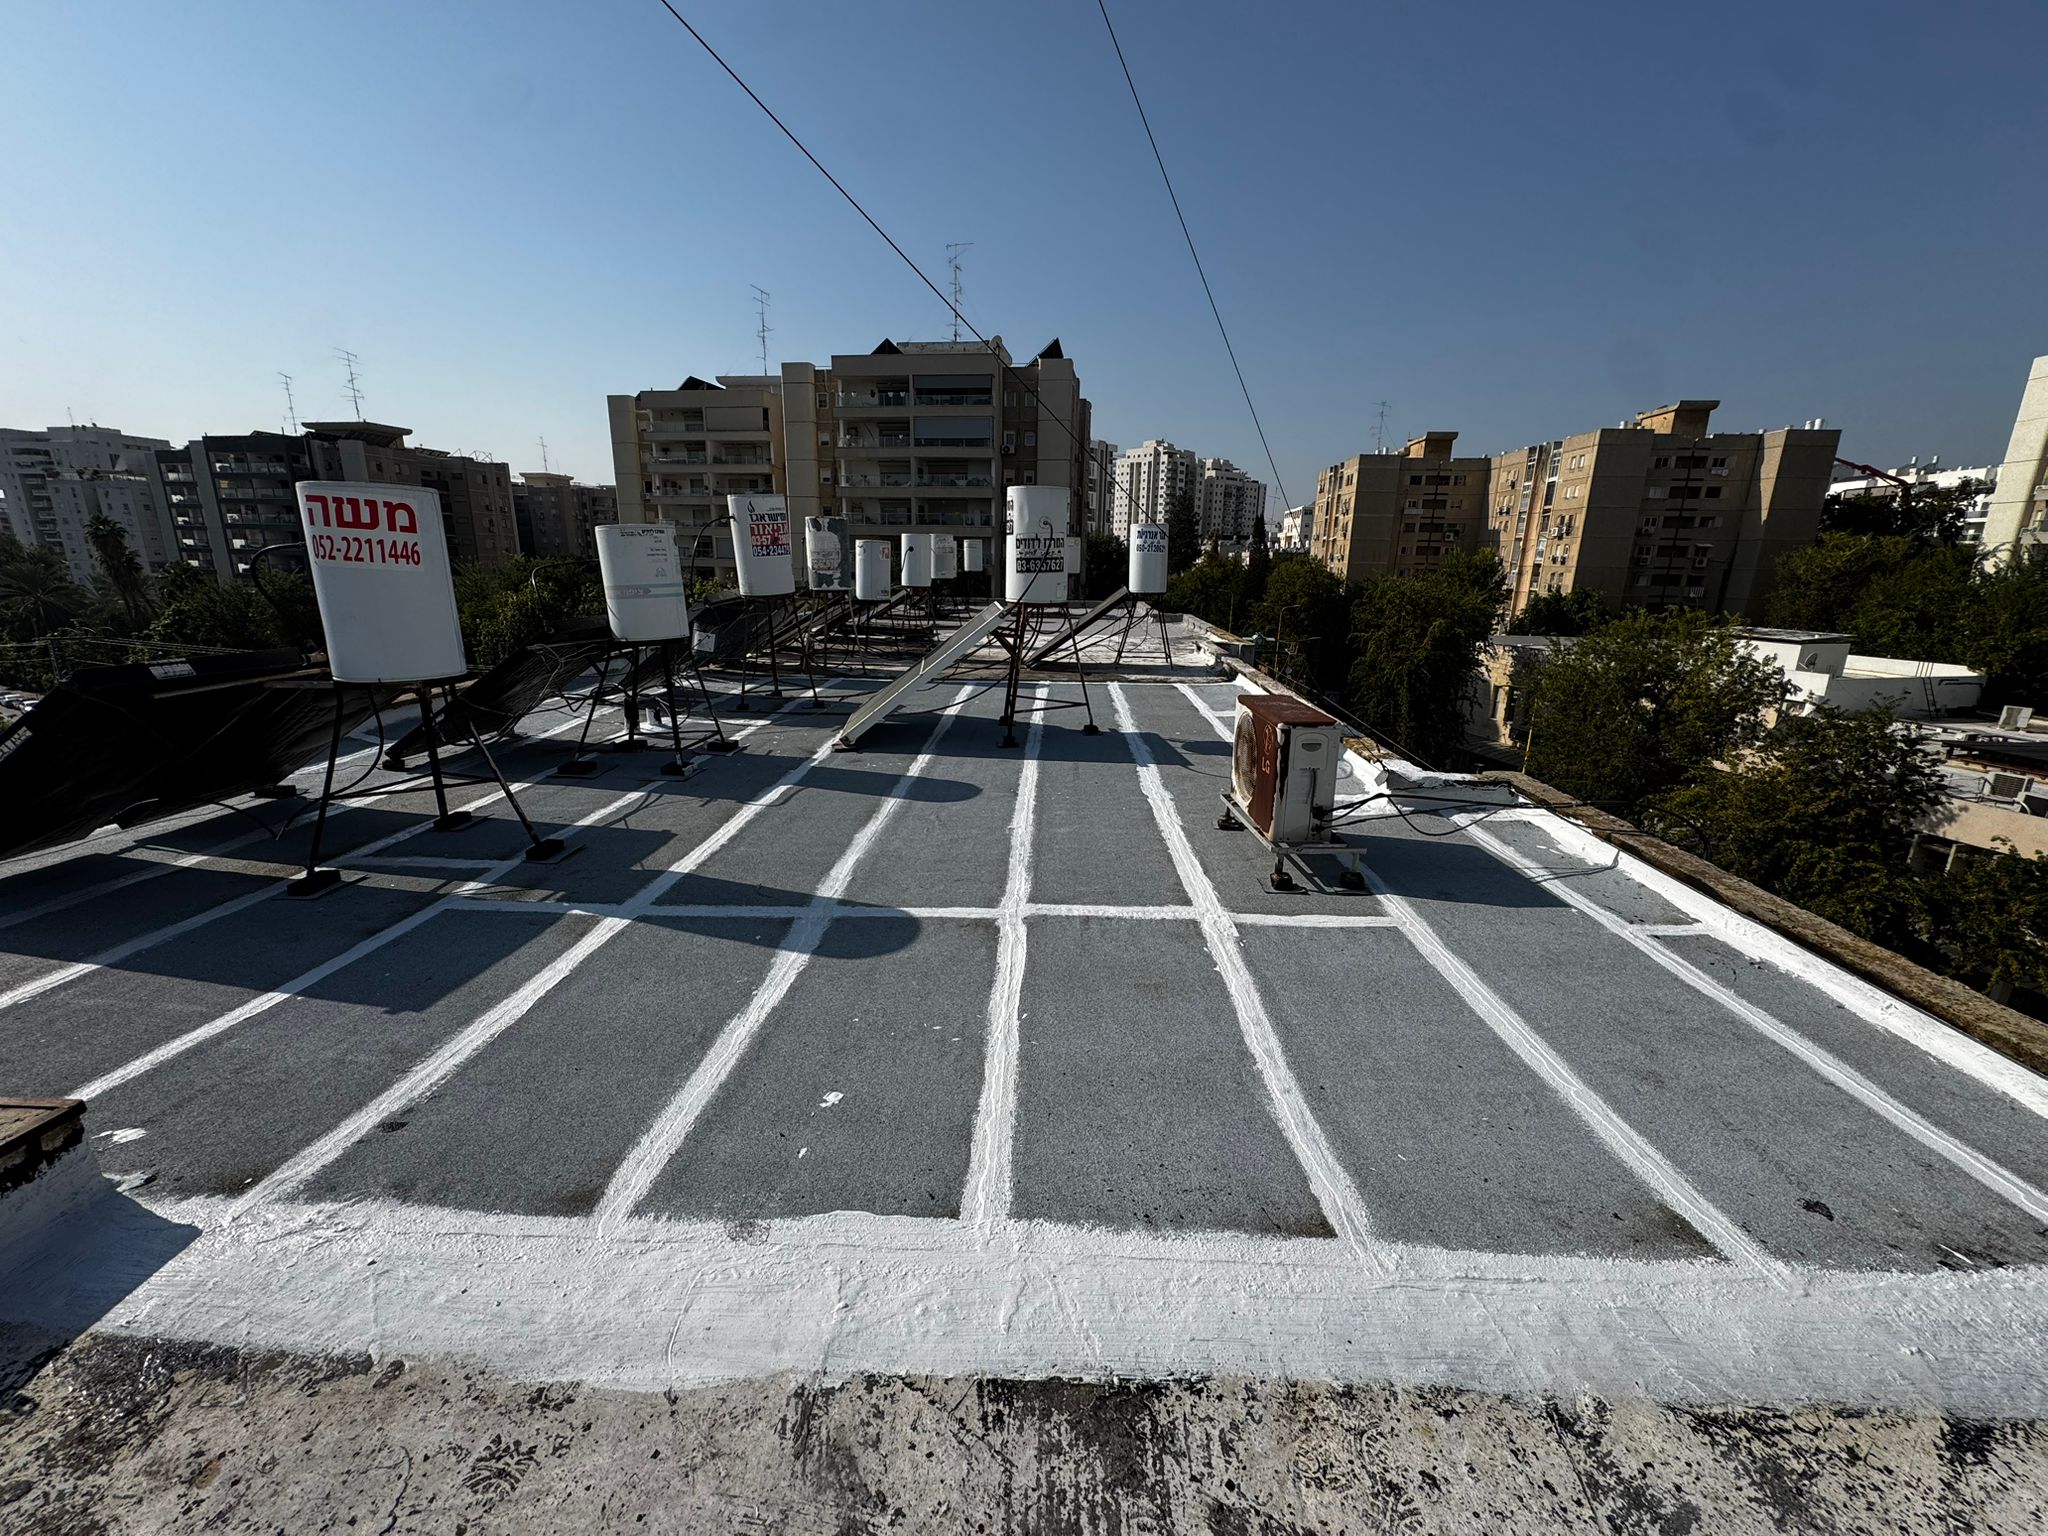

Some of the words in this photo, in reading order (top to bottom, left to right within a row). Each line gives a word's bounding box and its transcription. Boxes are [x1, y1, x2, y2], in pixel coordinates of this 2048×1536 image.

[305, 494, 418, 534] משה
[311, 534, 421, 566] 052-2211446
[1016, 533, 1041, 549] לדודים
[1261, 756, 1270, 775] LG
